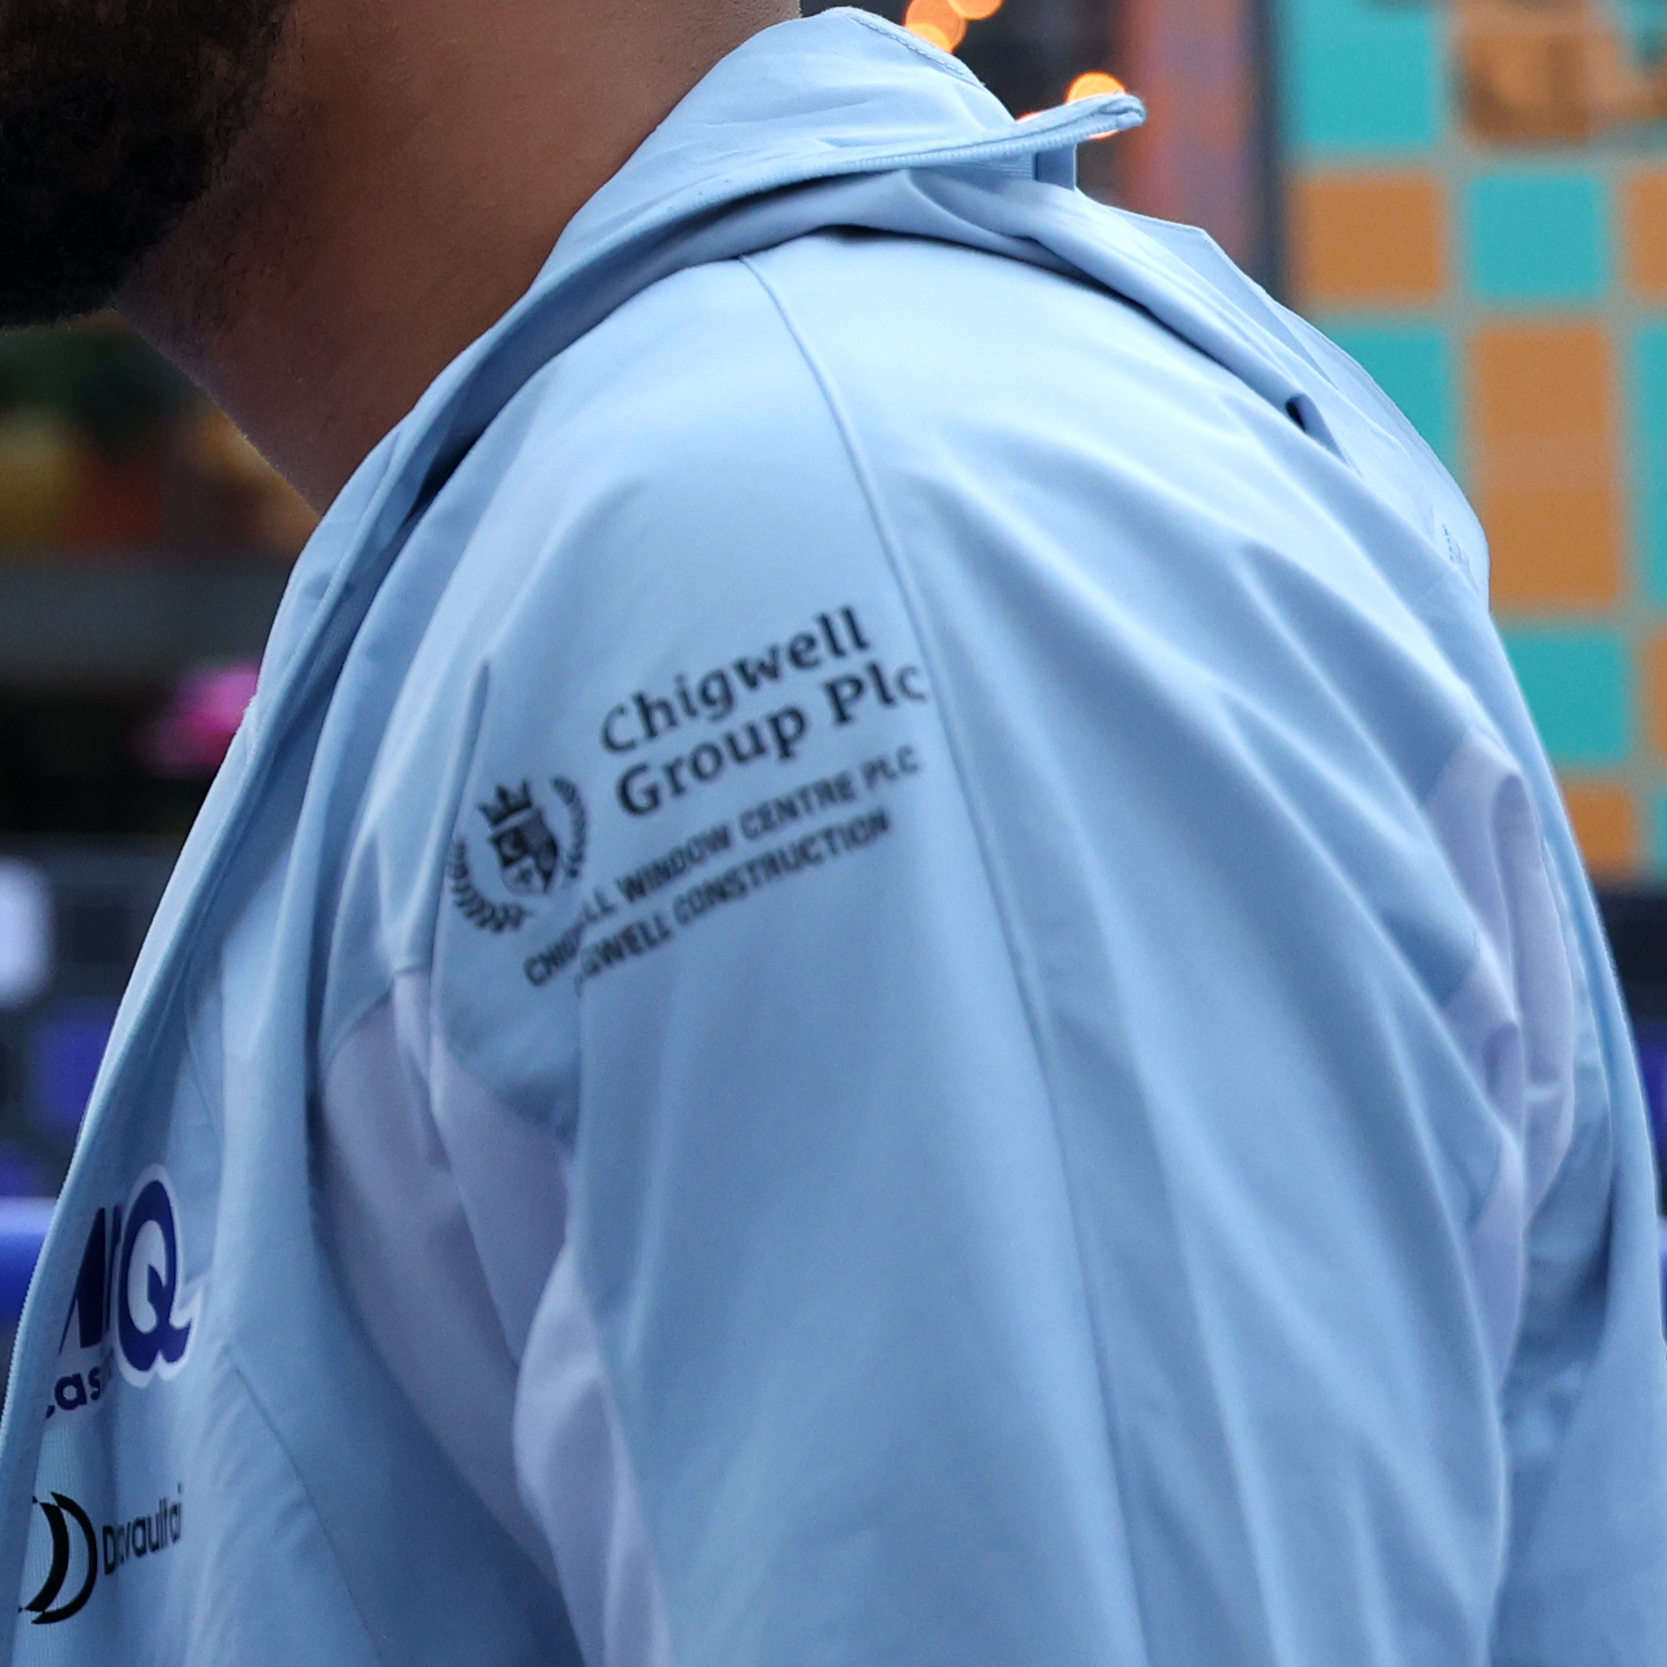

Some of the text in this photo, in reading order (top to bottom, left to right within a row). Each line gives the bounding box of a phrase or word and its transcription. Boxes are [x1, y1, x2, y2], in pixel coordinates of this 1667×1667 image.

[600, 605, 870, 754] Chigwell
[615, 660, 926, 816] Group Plc
[617, 821, 731, 905] WINDOW
[738, 769, 857, 840] CENTRE
[860, 744, 921, 790] PLC
[673, 805, 891, 927] CONSTRUCTION
